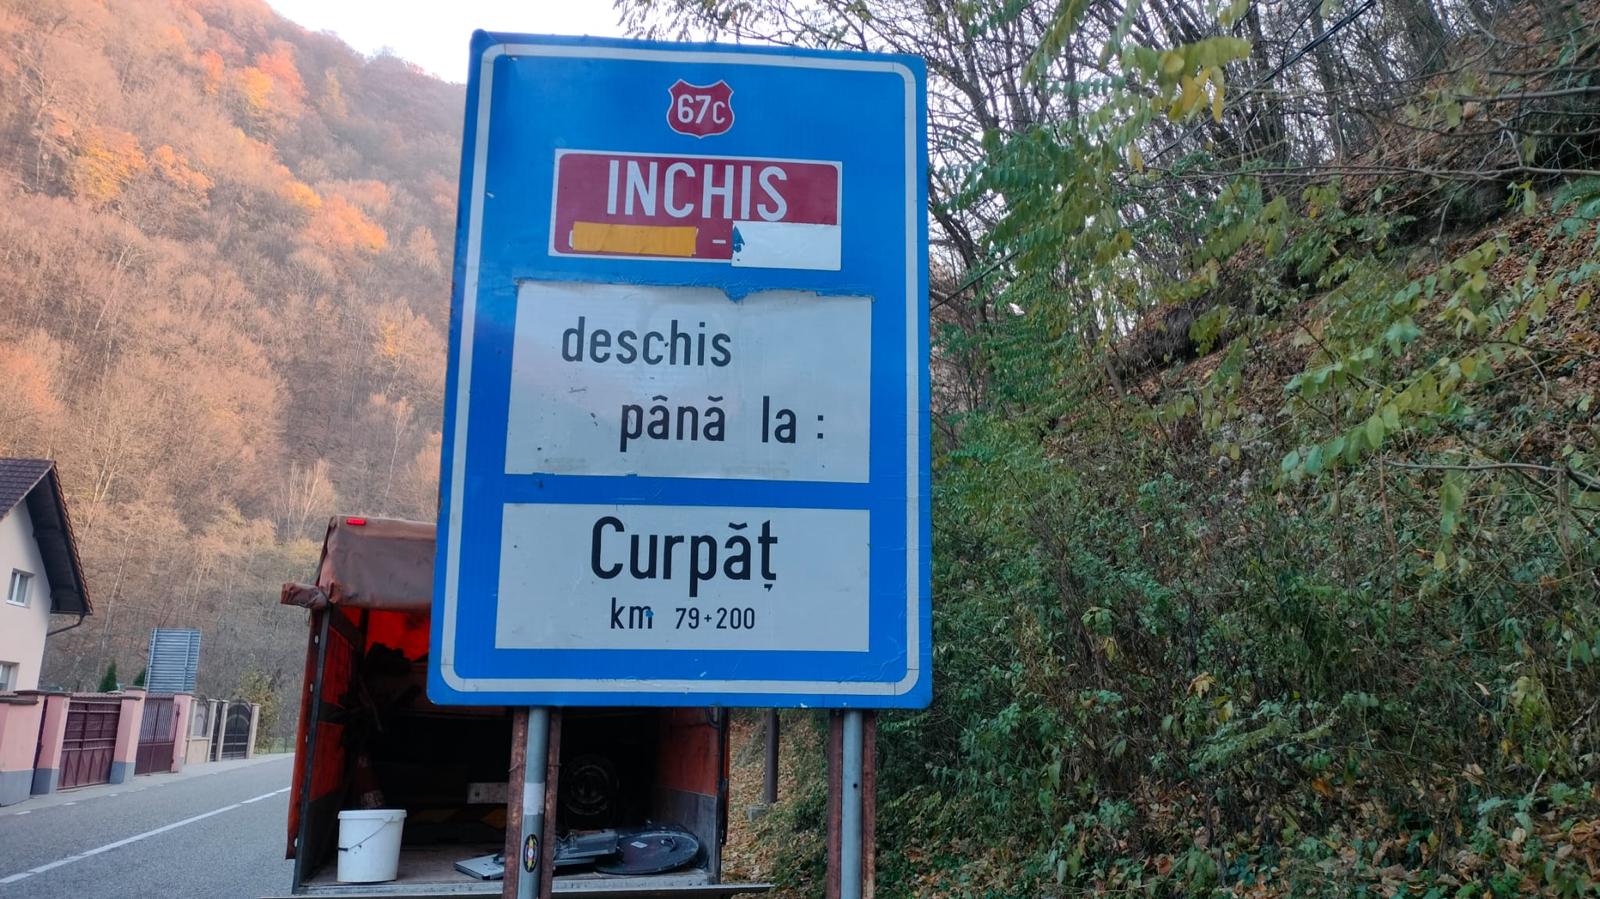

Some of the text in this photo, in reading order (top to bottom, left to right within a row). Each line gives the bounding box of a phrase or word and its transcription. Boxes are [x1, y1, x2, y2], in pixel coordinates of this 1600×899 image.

[607, 160, 788, 221] INCHIS
[562, 316, 731, 367] deschis
[619, 395, 725, 452] până
[591, 516, 778, 597] Curpăț
[610, 597, 755, 629] km 79+200
